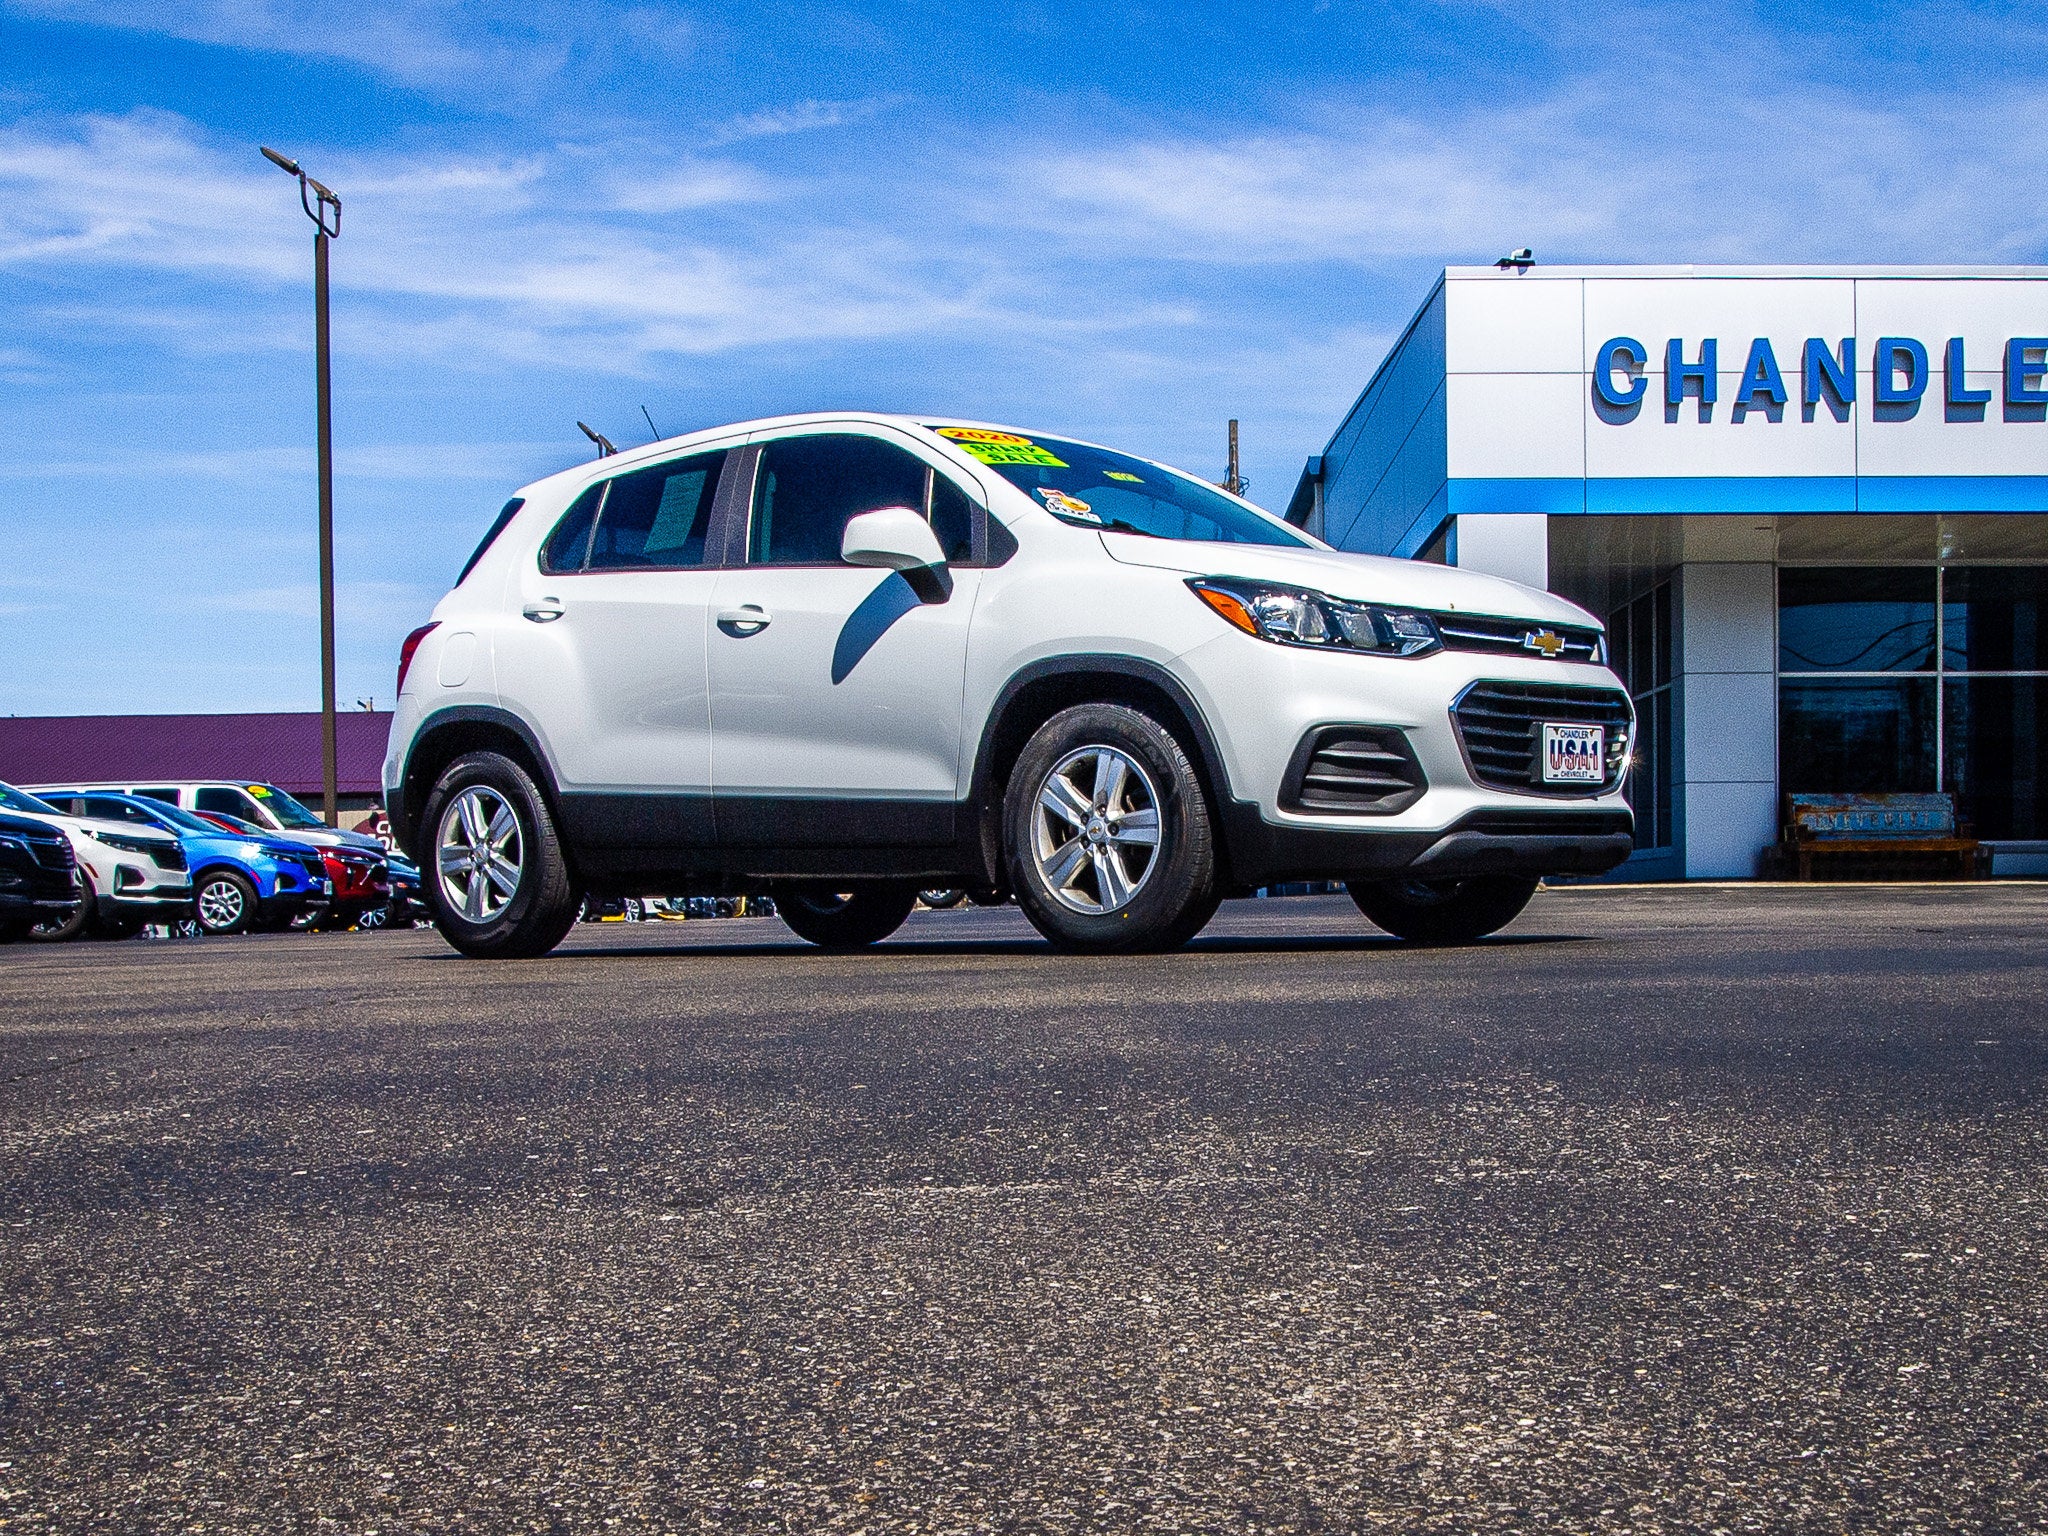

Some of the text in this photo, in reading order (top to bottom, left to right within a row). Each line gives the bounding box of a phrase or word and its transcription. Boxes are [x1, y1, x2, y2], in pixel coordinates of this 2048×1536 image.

[1594, 336, 2048, 405] CHANDLE
[948, 430, 1021, 443] 2020
[969, 444, 1036, 457] SHARP
[986, 454, 1052, 465] SALE
[1560, 729, 1589, 739] CHANDLER
[1560, 770, 1588, 778] CHEVROLET
